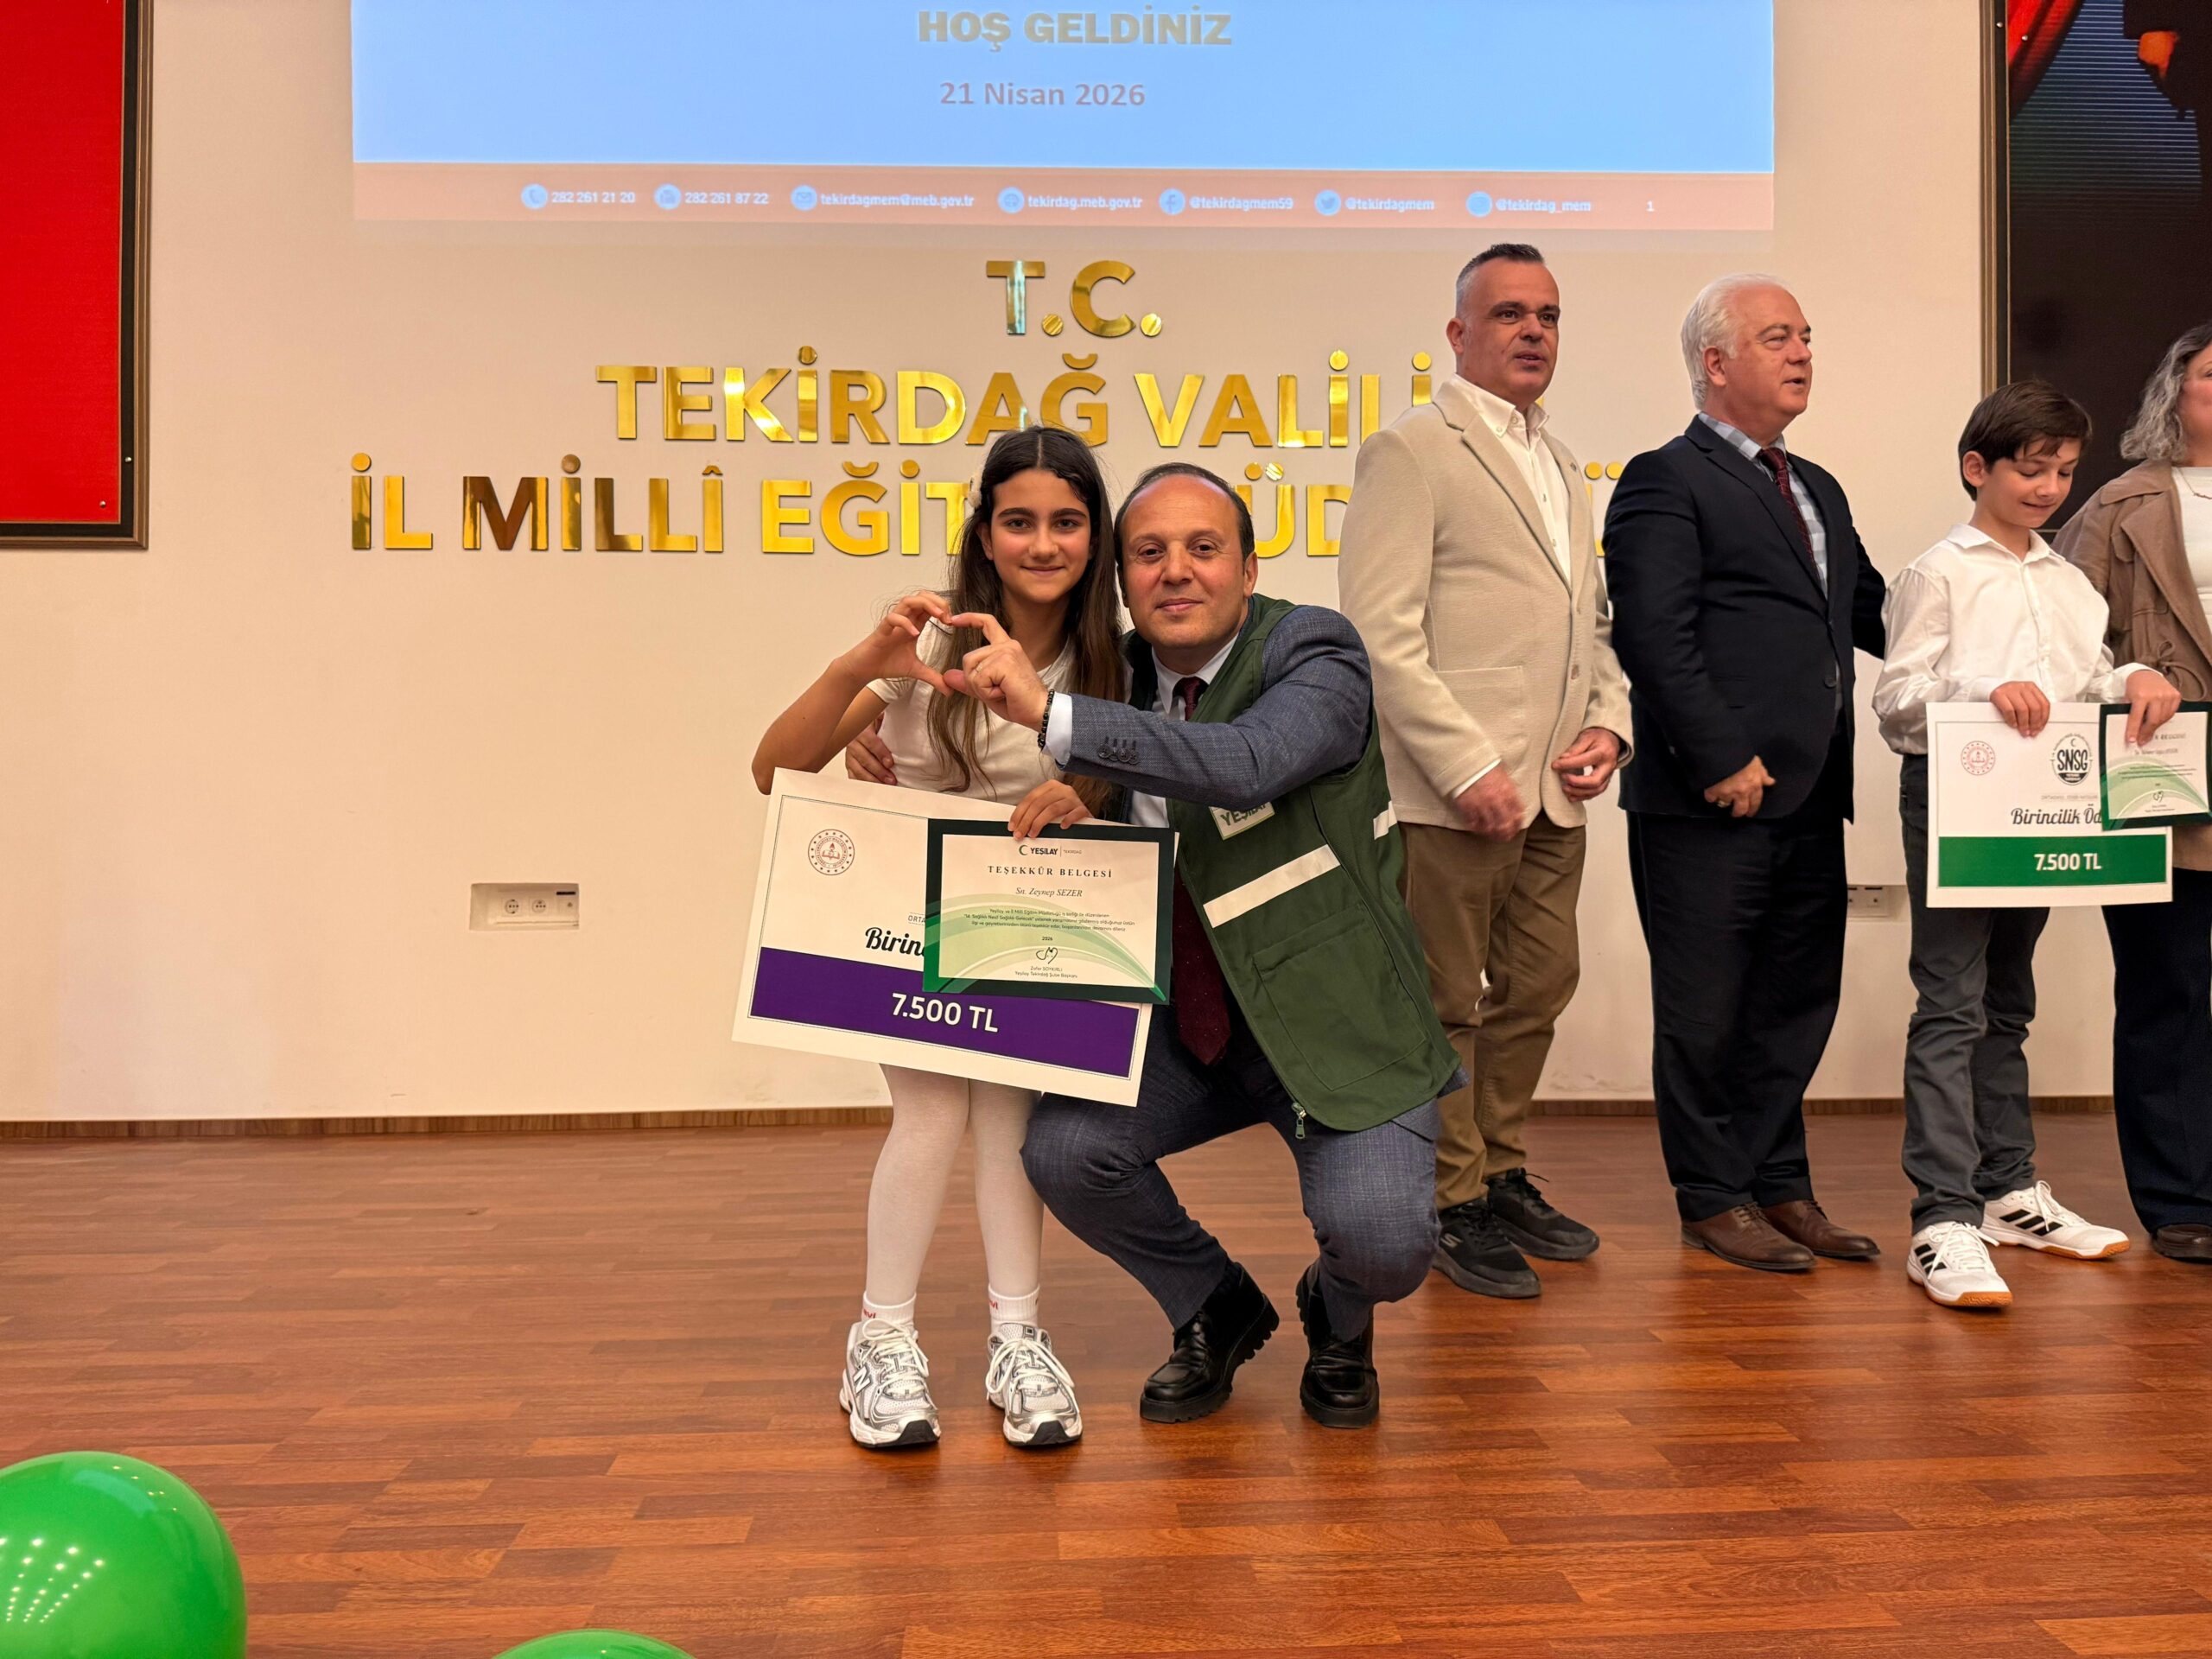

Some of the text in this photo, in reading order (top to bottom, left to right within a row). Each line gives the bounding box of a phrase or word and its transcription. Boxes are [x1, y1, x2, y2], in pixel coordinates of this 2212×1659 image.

[918, 4, 1232, 52] HOŞ GELDİNİZ
[940, 82, 1145, 105] 21 Nisan 2026
[551, 192, 636, 203] 282 261 21 20
[684, 192, 769, 204] 282 261 87 22
[821, 193, 975, 208] tekirdagmem@meb.gov.tr
[1028, 195, 1142, 210] tekirdag.meb.gov.tr
[1190, 196, 1294, 211] @tekirdagmem59
[1345, 198, 1435, 213] @tekirdagmem
[1496, 199, 1592, 213] @tekirdag_mem
[1646, 201, 1655, 212] 1
[986, 260, 1164, 338] T.C.
[596, 346, 1109, 448] TEKİRDAĞ
[352, 452, 970, 556] İL MİLLÎ EĞİT
[2057, 748, 2088, 771] SNSG
[2011, 803, 2102, 824] Birincilik Öd
[1030, 847, 1058, 855] YEŞİLAY
[2034, 853, 2102, 871] 7.500 TL
[988, 865, 1112, 878] TEŞEKKÜR BELGESİ
[1028, 887, 1055, 898] Zeynep
[1056, 888, 1083, 897] SEZER
[908, 914, 925, 923] ORTA
[892, 993, 998, 1033] 7.500 TL
